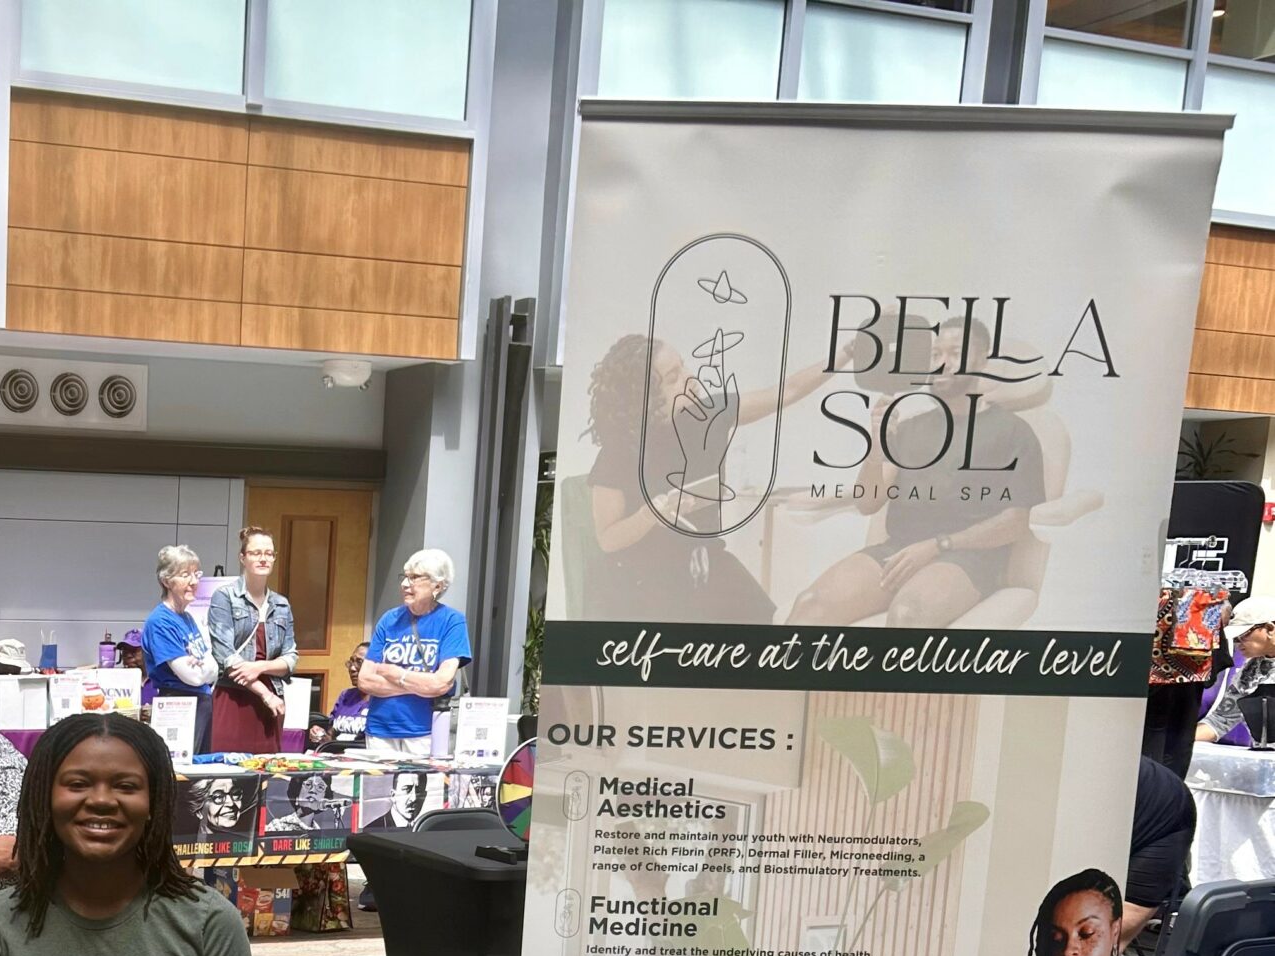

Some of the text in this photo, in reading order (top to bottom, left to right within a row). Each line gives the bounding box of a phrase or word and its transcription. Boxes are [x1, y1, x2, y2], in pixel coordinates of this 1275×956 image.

[823, 295, 1120, 384] BELLA
[810, 483, 1014, 502] MEDICAL SPA
[596, 629, 1121, 680] self-care at the cellular level
[548, 724, 793, 750] OUR SERVICES :
[600, 777, 693, 796] Medical
[597, 799, 725, 819] Aesthetics
[214, 842, 231, 854] LIKE
[232, 840, 253, 854] ROSA
[272, 839, 293, 851] DARE
[295, 838, 311, 850] LIKE
[595, 830, 921, 847] Restore and maintain your youth with Neuromodulators,
[594, 845, 639, 855] Platelet
[643, 846, 667, 855] Rich
[672, 847, 704, 856] Fibrin
[708, 848, 744, 858] (PRF),
[749, 848, 789, 859] Dermal
[794, 850, 826, 860] Filler,
[830, 850, 914, 863] Microneedling,
[593, 862, 920, 877] range of Chemical Peels, and Biostimulatory Treatments.
[591, 896, 718, 915] Functional
[589, 917, 697, 936] Medicine
[587, 945, 631, 956] Identify
[635, 946, 656, 955] and
[660, 947, 686, 955] treat
[691, 947, 708, 956] the
